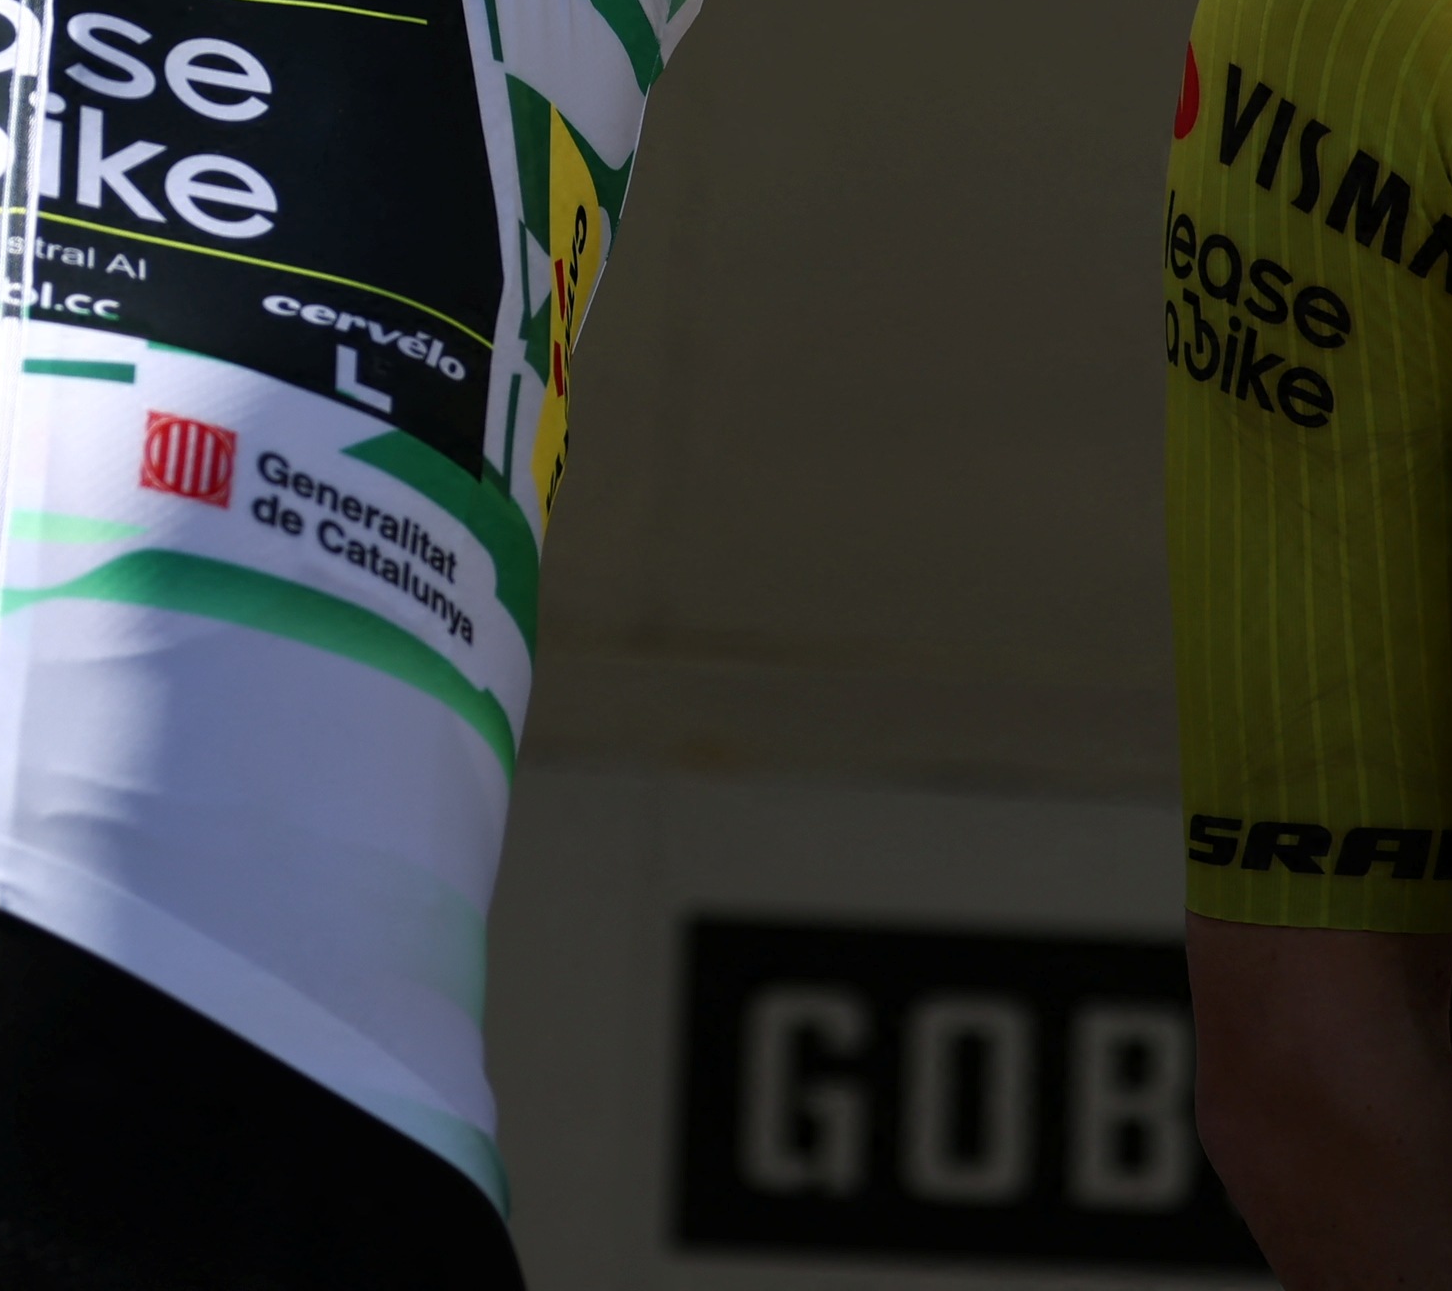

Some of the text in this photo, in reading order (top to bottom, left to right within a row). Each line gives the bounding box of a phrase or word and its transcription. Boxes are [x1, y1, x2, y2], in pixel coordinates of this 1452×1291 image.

[262, 295, 466, 382] cervélo
[252, 494, 475, 646] de Catalunya
[256, 450, 457, 584] Generalitat
